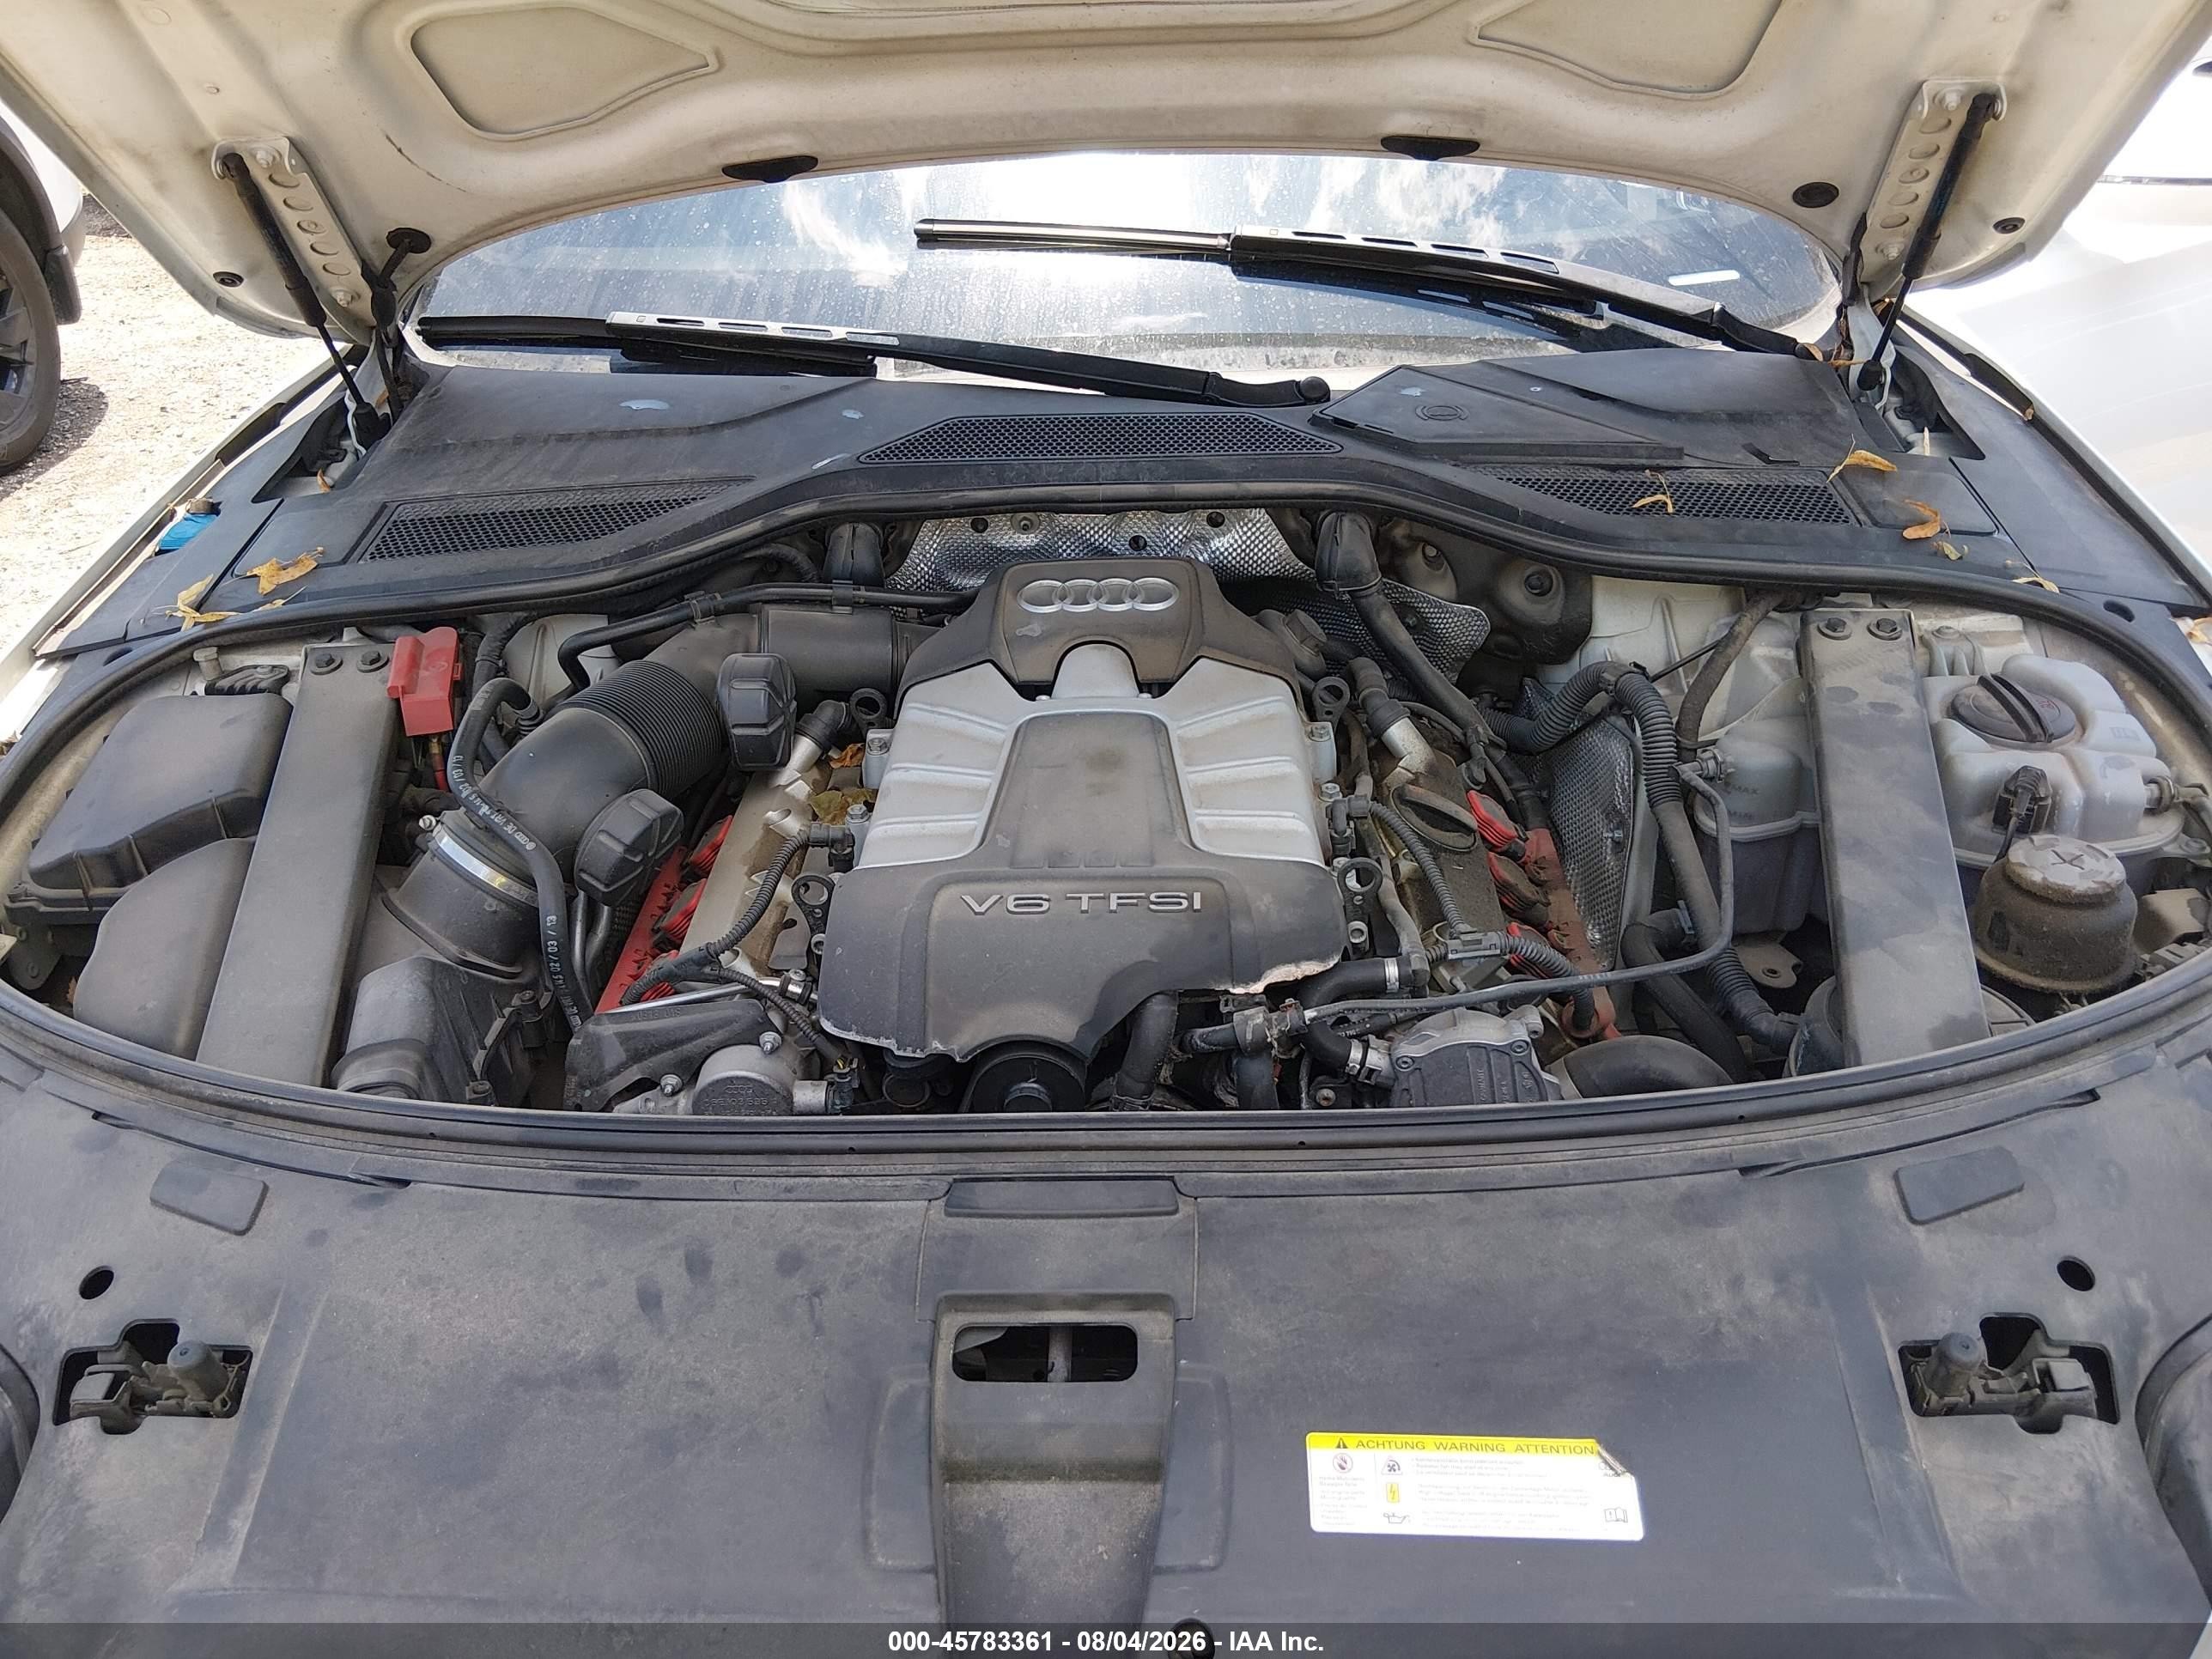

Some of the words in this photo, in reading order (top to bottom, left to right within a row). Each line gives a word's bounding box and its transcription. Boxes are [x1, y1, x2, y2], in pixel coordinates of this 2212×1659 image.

[961, 894, 1051, 915] V6
[1065, 892, 1202, 914] TFSI
[1356, 1440, 1425, 1450] ACHTUNG
[1434, 1442, 1505, 1453] WARNING
[1515, 1443, 1595, 1455] ATTENTION
